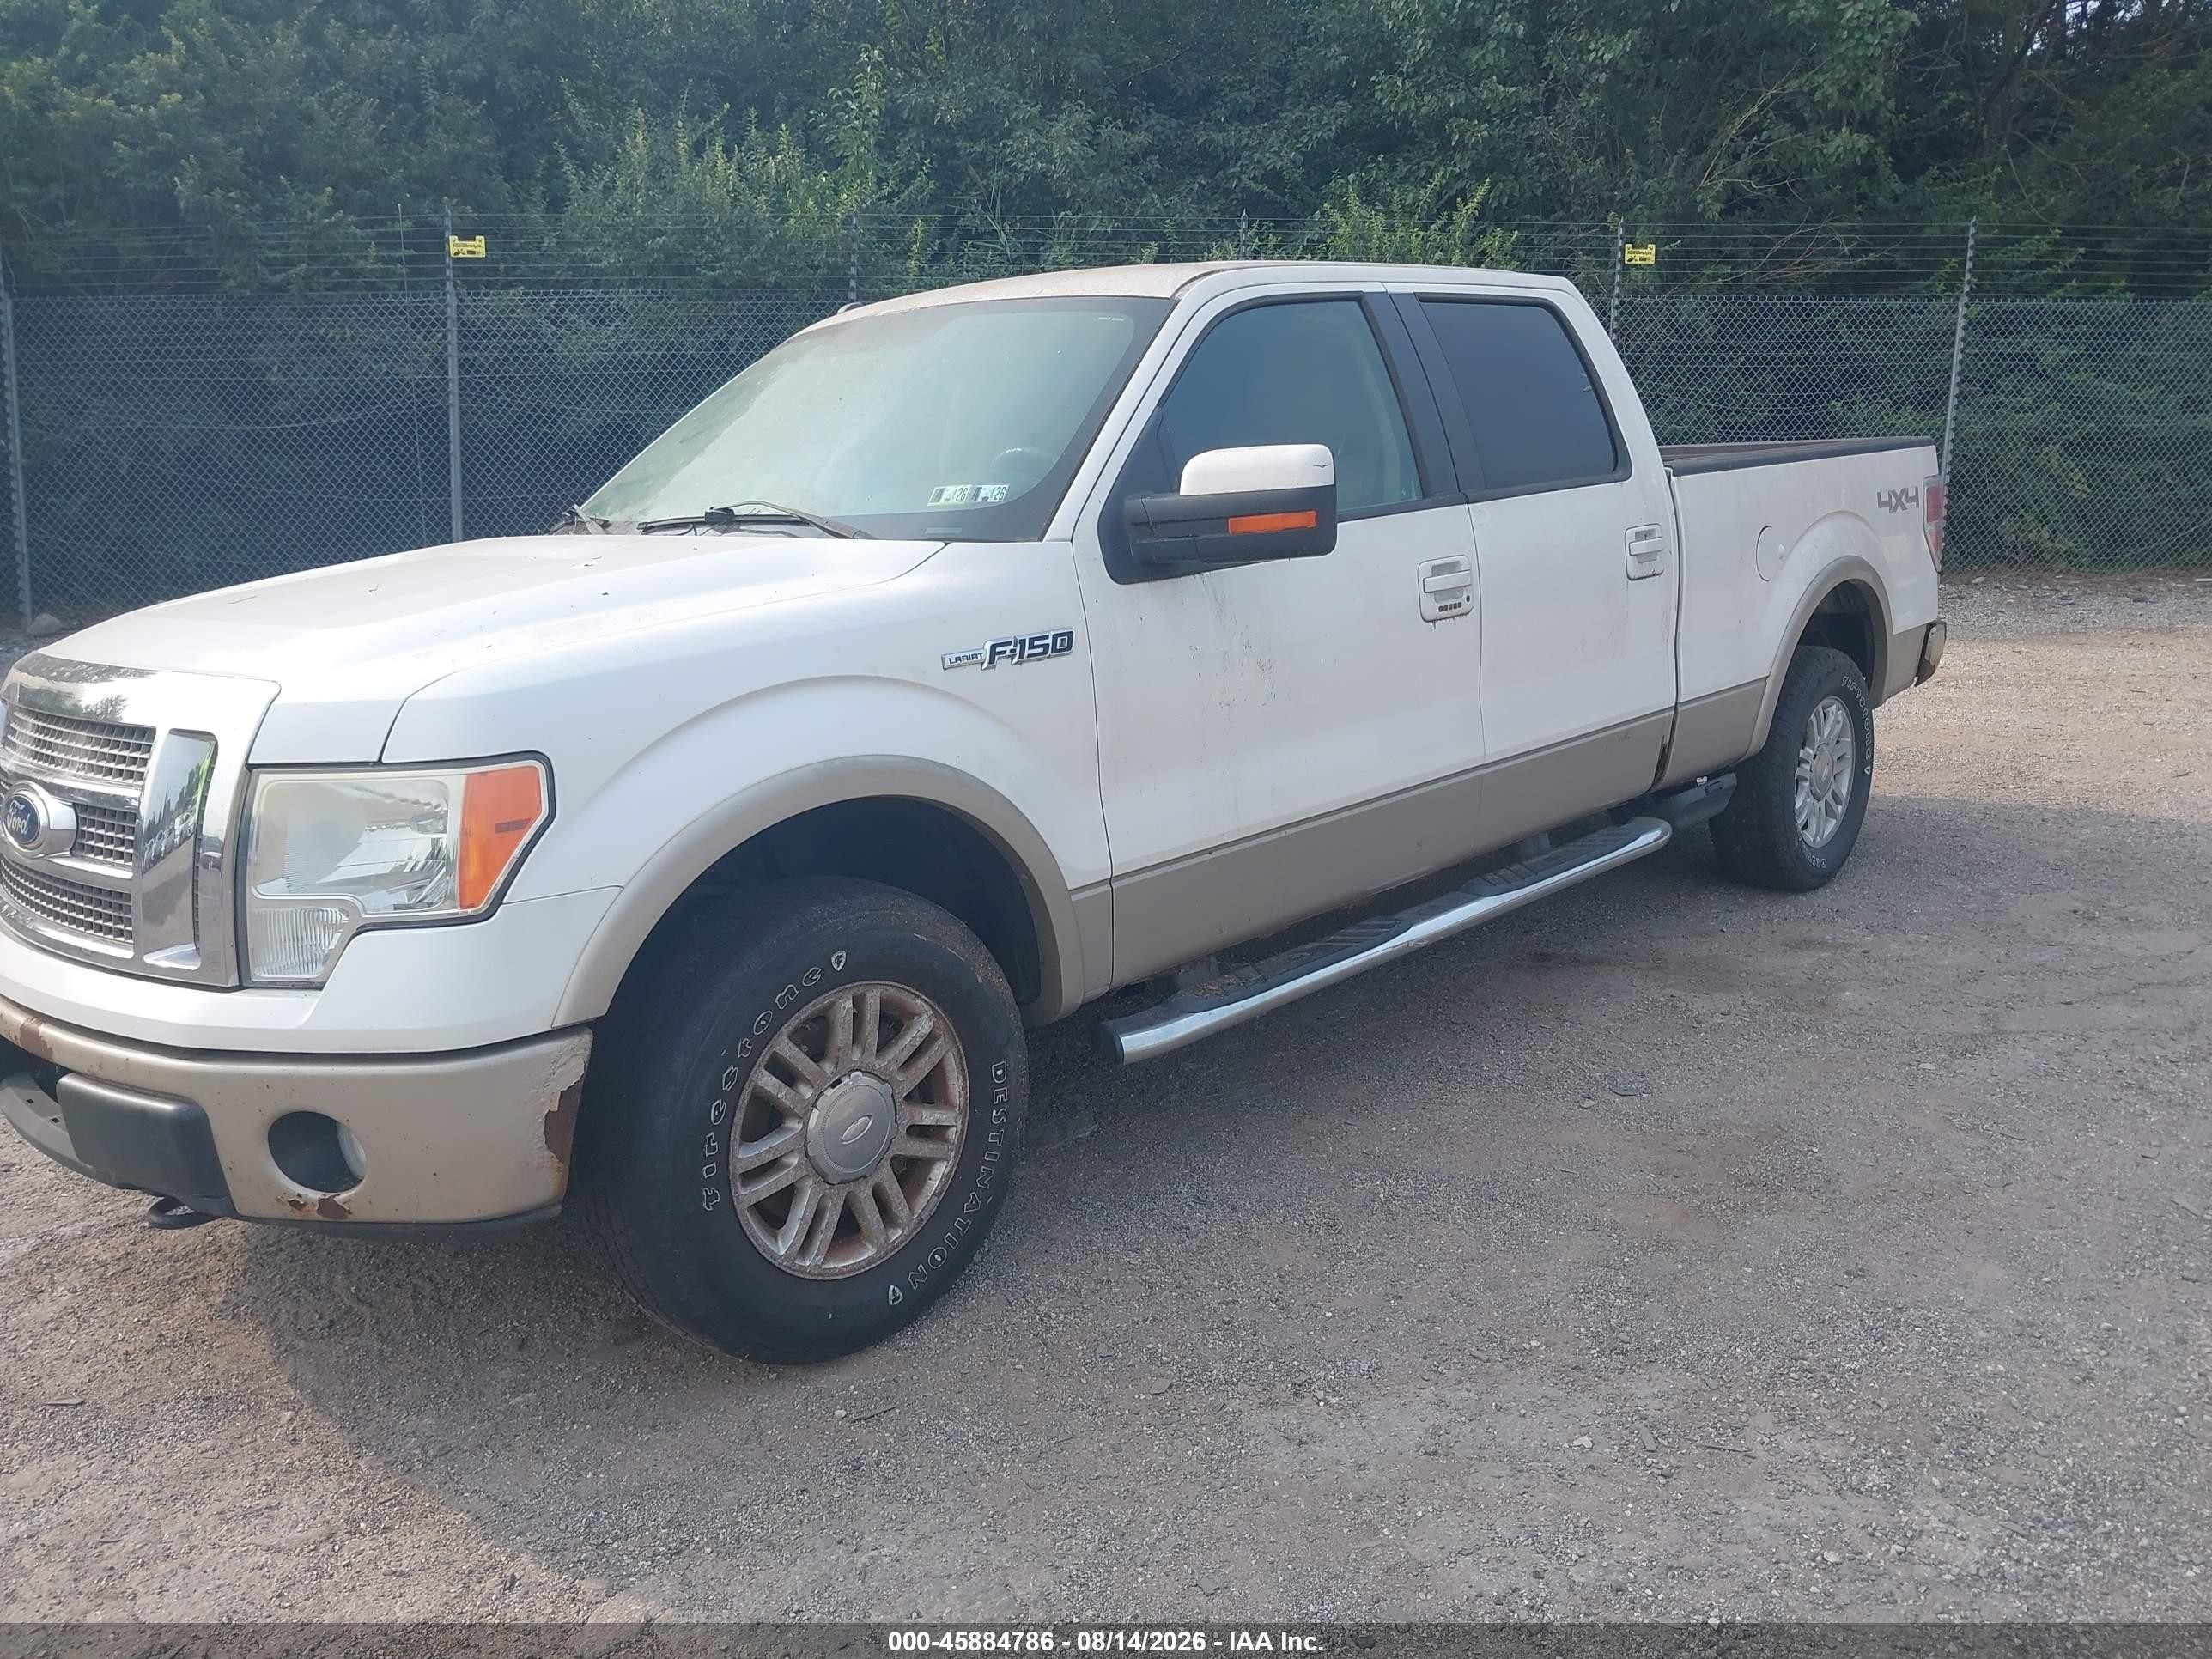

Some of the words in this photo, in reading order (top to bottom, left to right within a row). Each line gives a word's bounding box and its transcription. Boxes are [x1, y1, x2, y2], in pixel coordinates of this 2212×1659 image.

[955, 487, 969, 501] 26
[994, 486, 1006, 501] 26
[948, 652, 984, 665] LARIAT
[987, 629, 1075, 666] F-150
[6, 799, 32, 835] Ford
[908, 1060, 1010, 1290] DESTINATION
